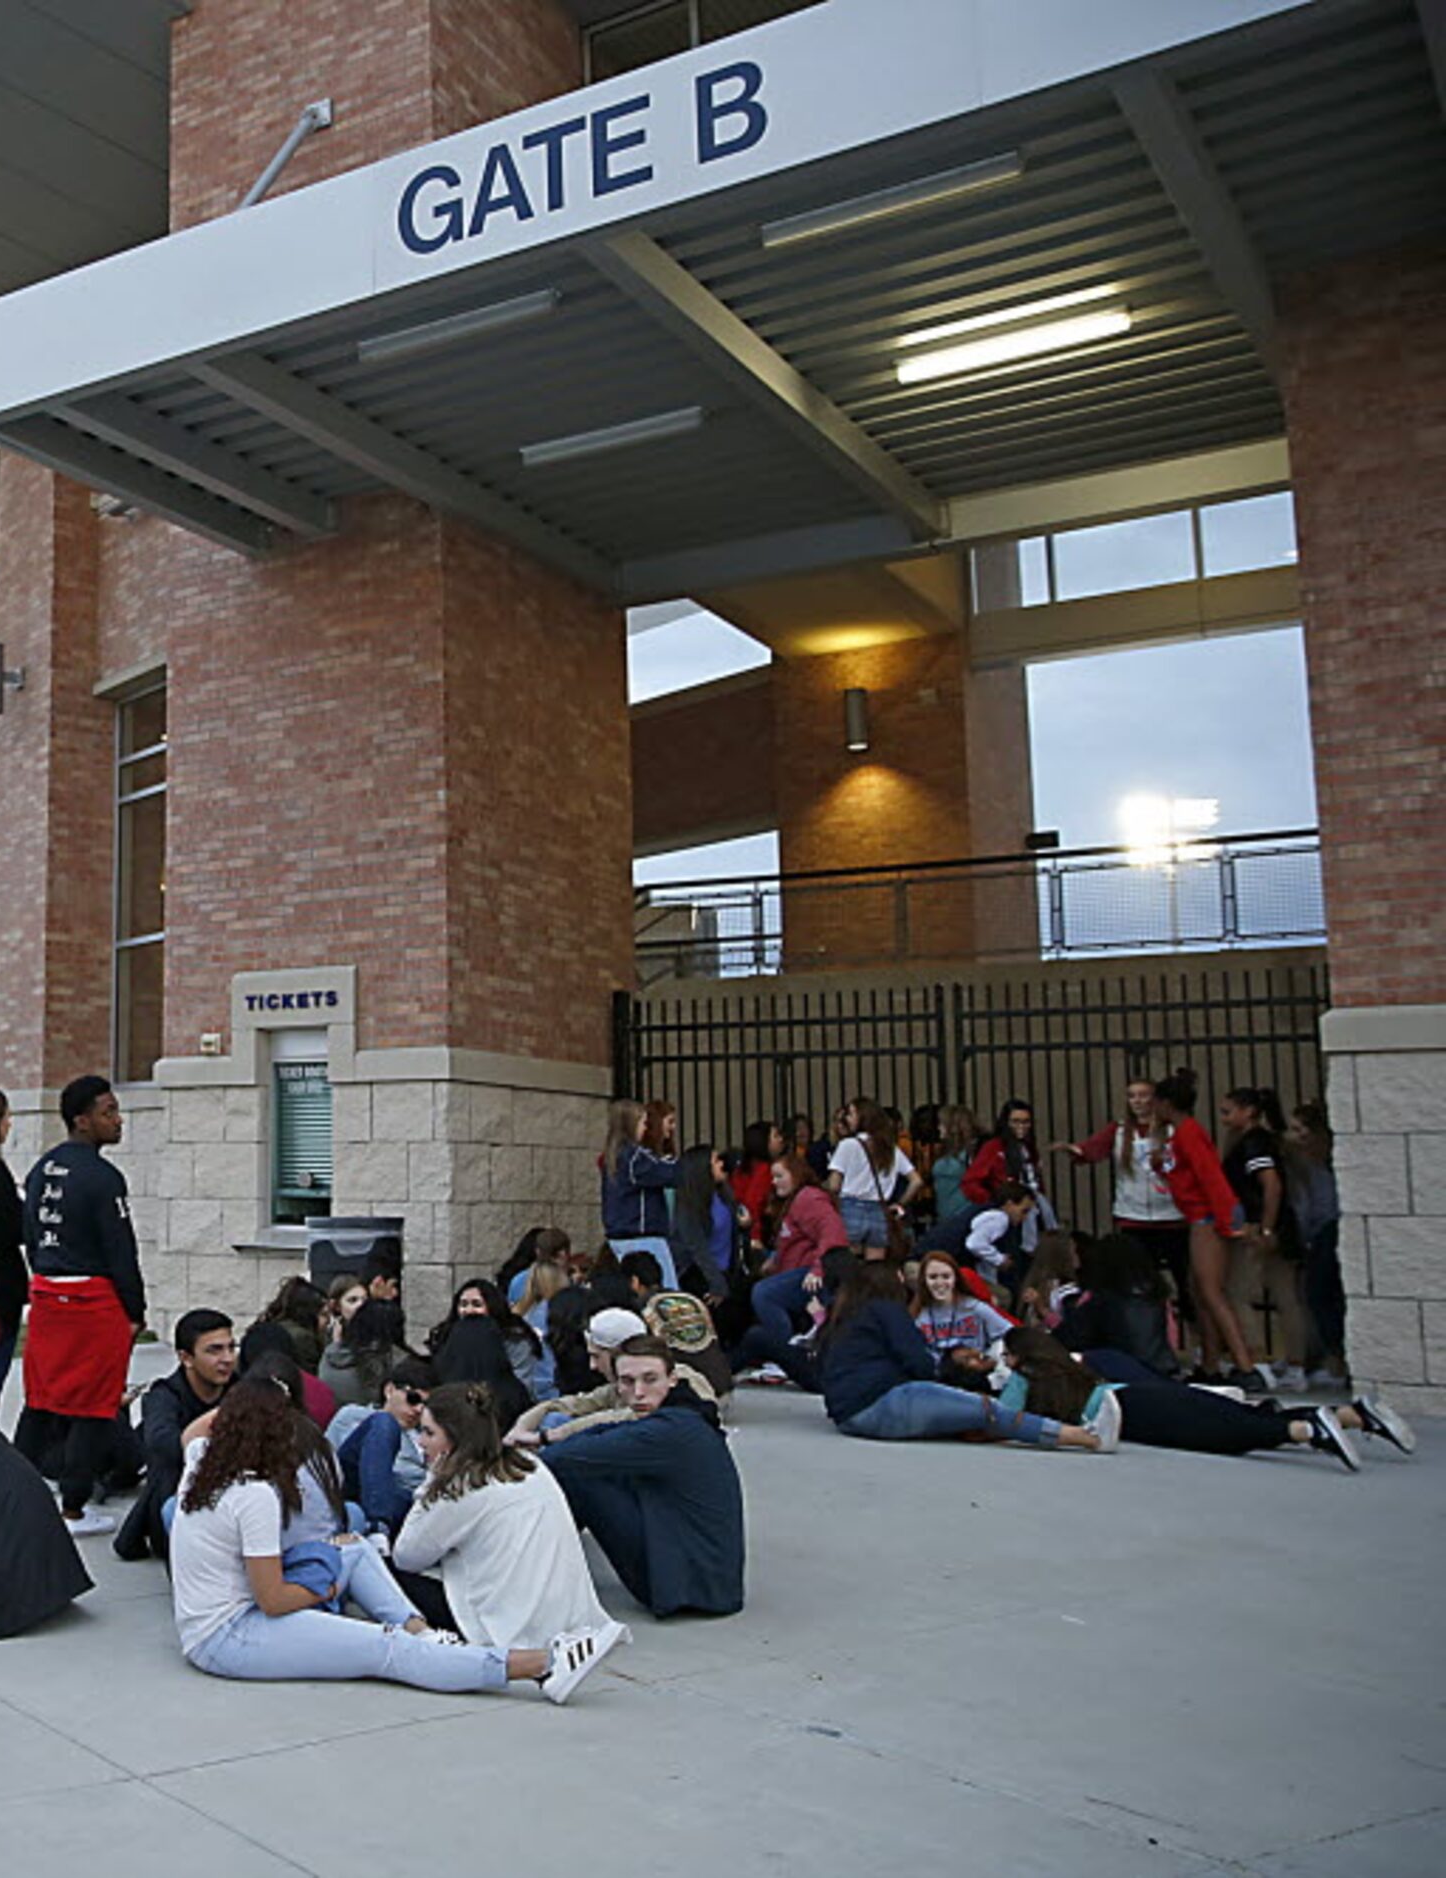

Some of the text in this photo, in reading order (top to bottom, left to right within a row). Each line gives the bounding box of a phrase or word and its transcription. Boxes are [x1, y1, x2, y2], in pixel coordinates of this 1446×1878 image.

[397, 60, 769, 255] GATE B
[244, 989, 339, 1012] TICKETS
